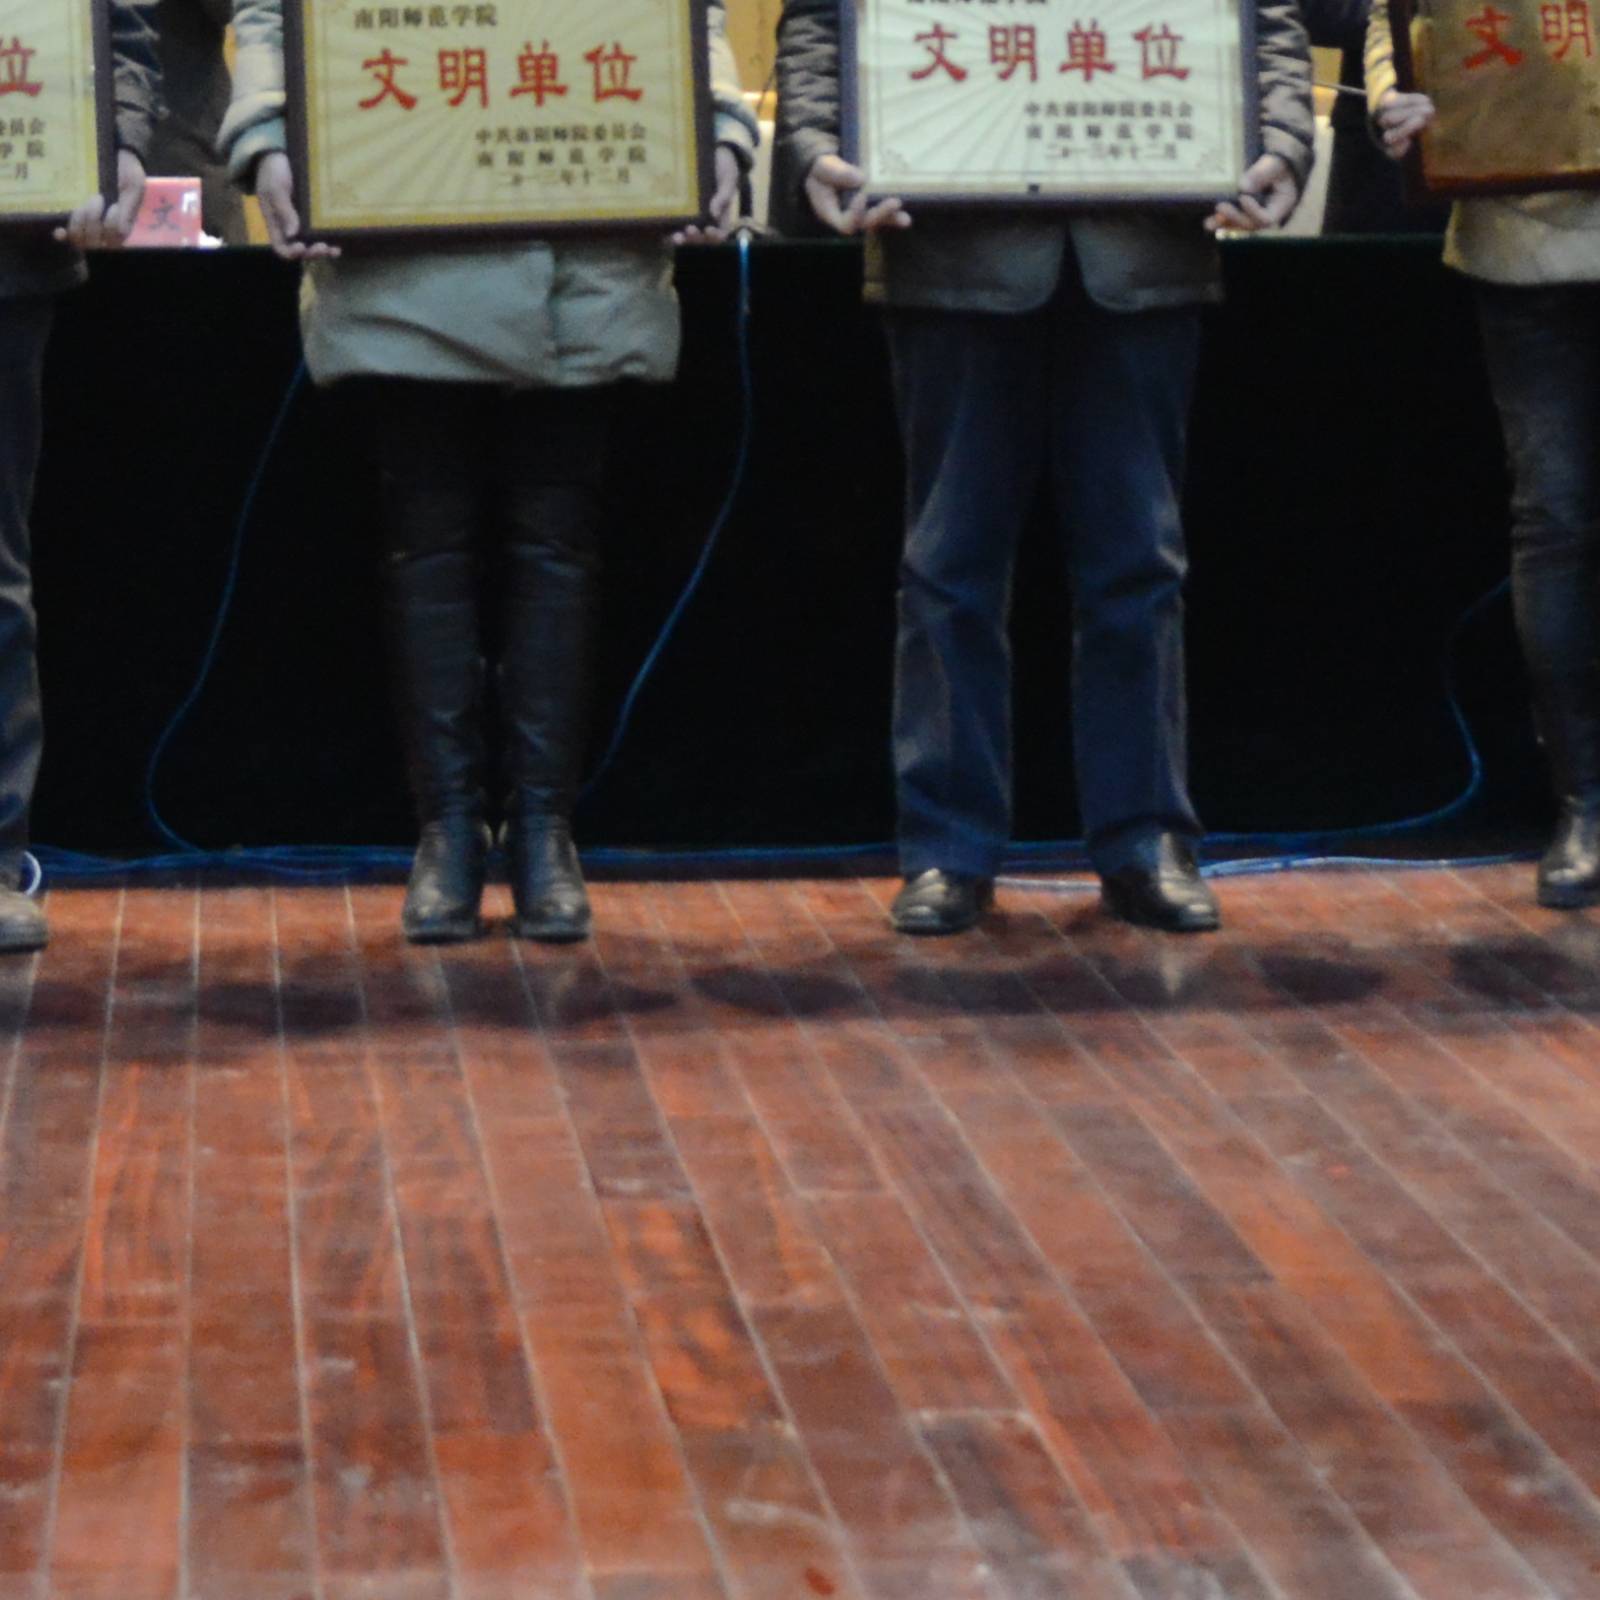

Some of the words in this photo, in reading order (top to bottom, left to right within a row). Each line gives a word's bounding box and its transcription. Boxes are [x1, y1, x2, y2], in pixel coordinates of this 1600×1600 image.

[355, 4, 497, 29] 南阳师范学院
[909, 18, 1190, 82] 文明单位
[358, 40, 643, 111] 文明单位
[1025, 102, 1193, 117] 中共南阳师院委员会
[475, 122, 646, 144] 中共南阳师院委员会
[1026, 124, 1193, 140] 南阳师范学院
[477, 147, 646, 167] 南阳师范学院
